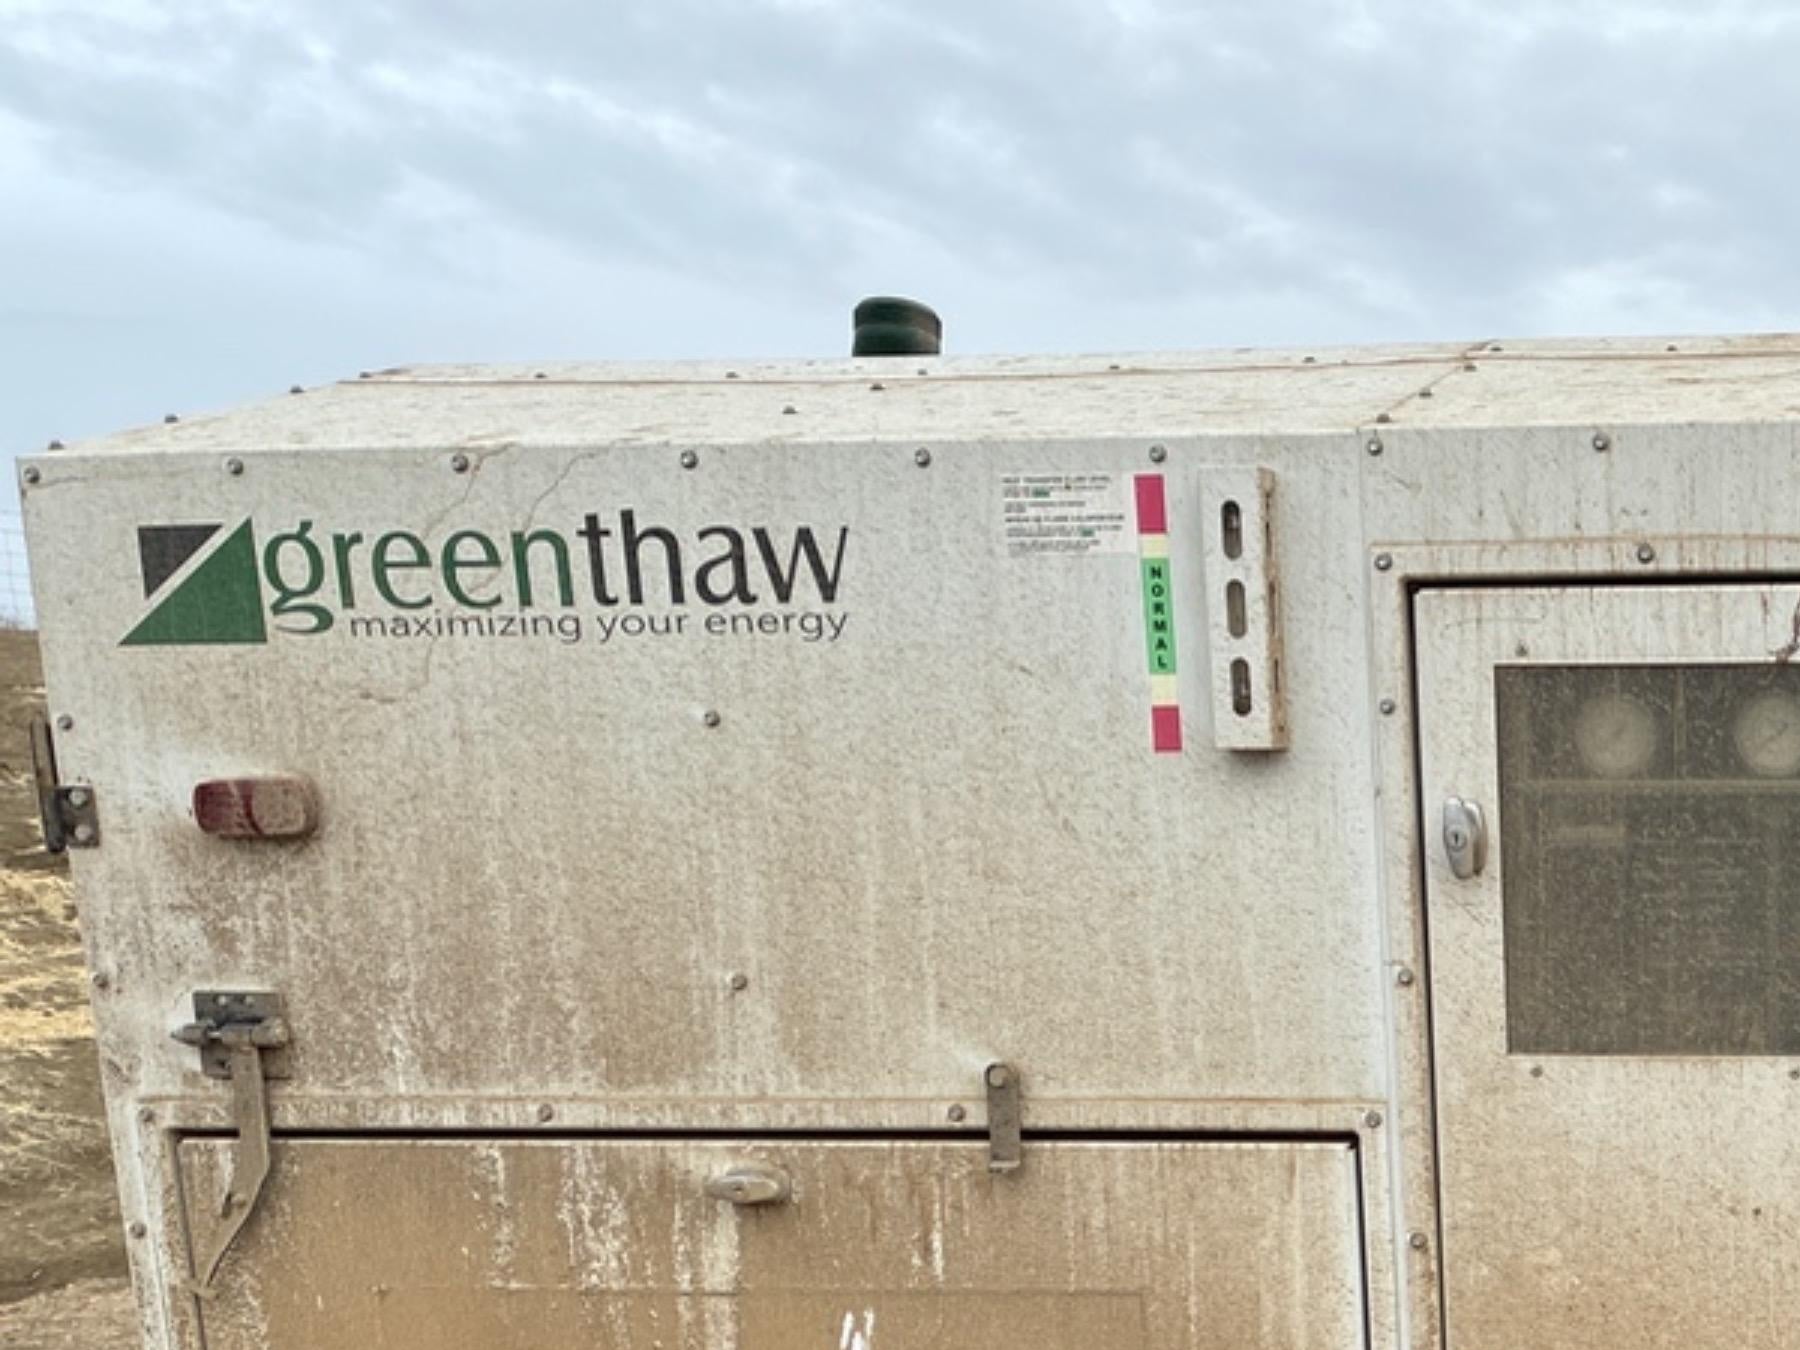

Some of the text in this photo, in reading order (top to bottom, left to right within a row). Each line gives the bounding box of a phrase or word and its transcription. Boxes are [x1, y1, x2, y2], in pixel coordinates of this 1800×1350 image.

[263, 508, 849, 634] greenthaw
[1150, 566, 1168, 669] NORMAL
[349, 608, 849, 645] maximizing your energy
